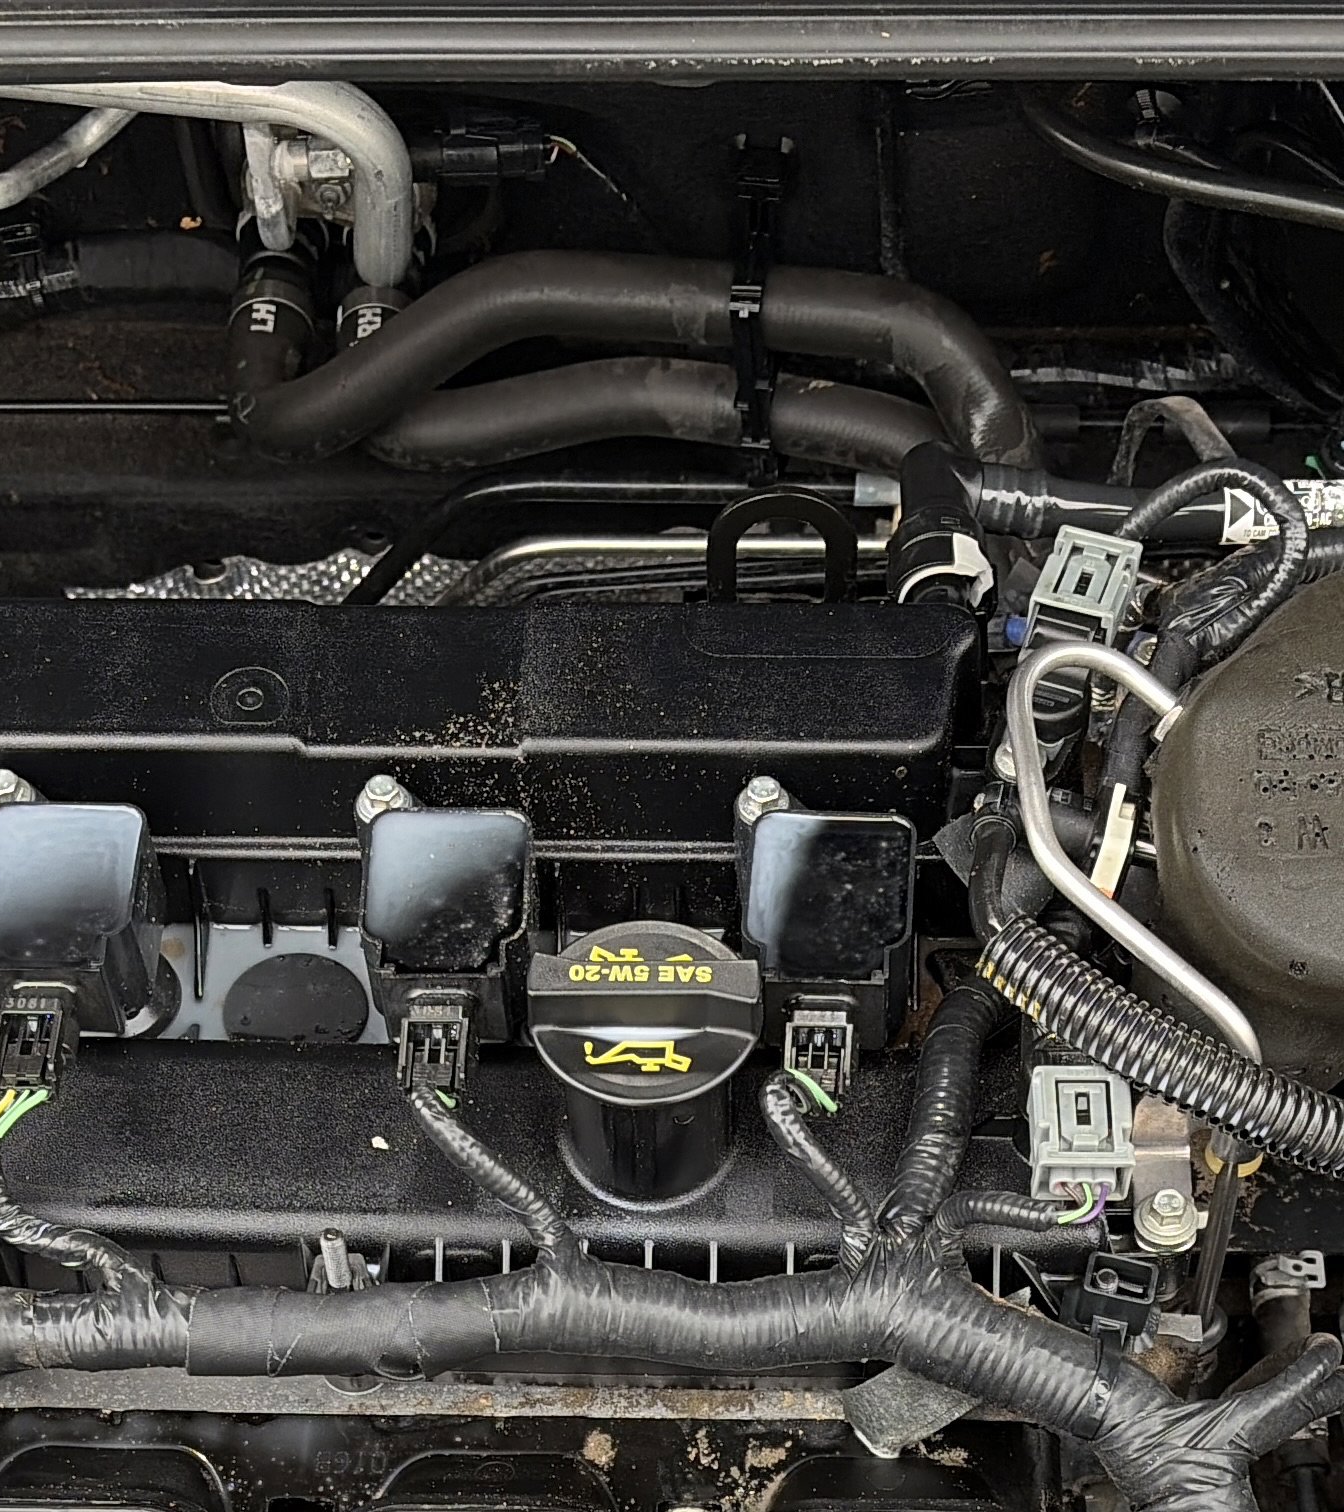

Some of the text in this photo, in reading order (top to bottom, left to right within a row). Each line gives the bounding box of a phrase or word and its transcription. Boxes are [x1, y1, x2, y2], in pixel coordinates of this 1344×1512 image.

[249, 302, 276, 332] LH
[568, 964, 711, 981] SAE 5W-20
